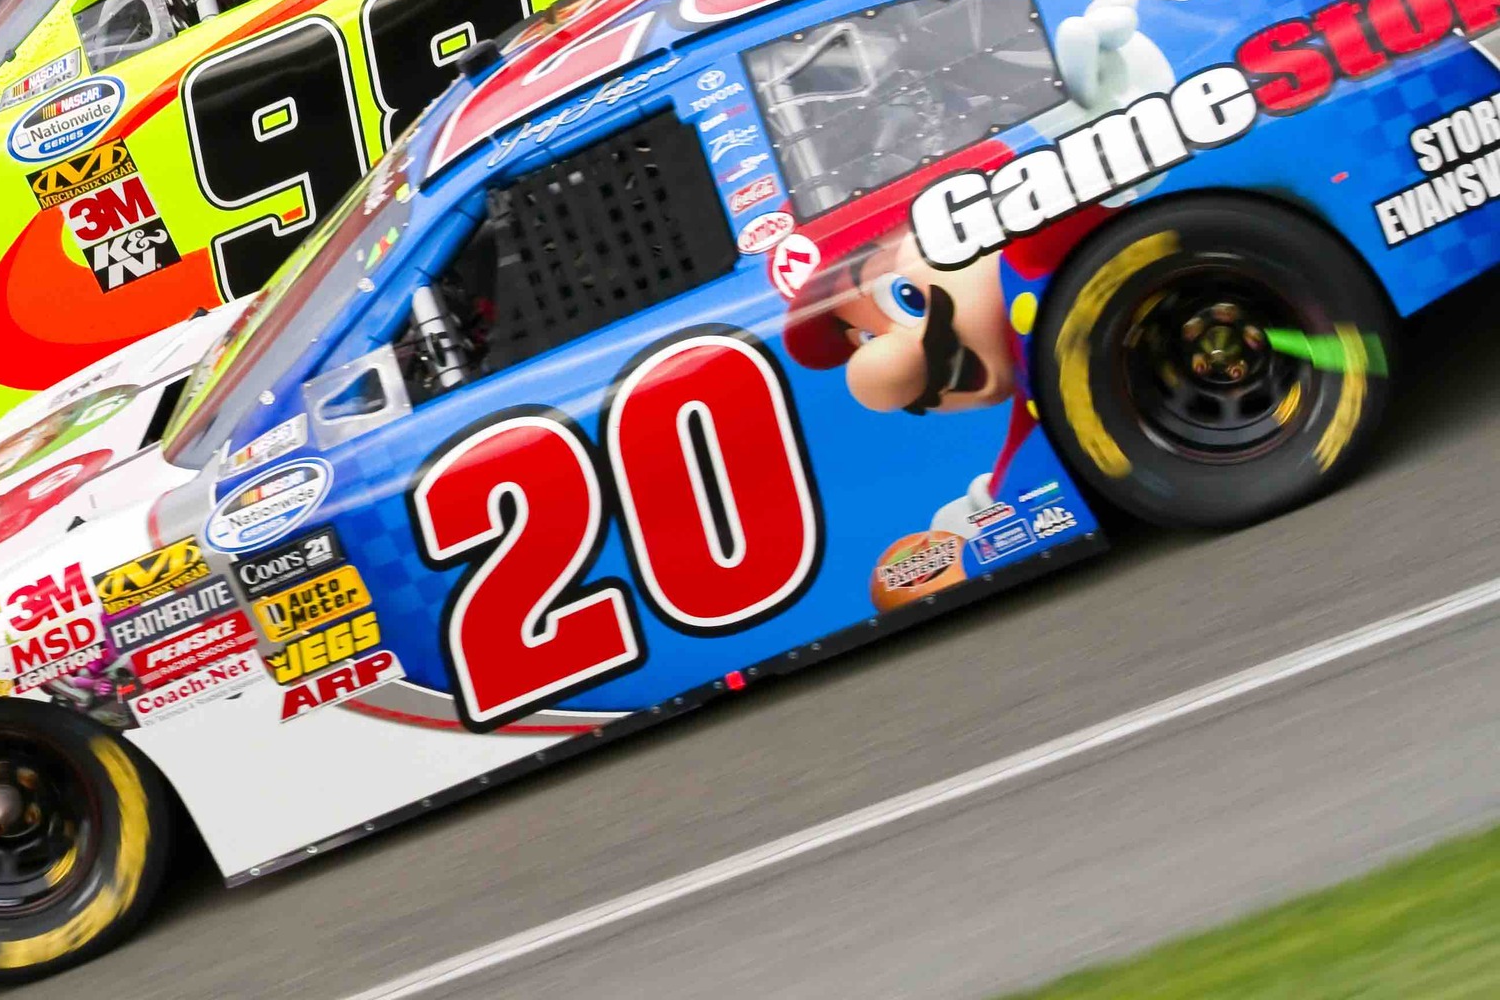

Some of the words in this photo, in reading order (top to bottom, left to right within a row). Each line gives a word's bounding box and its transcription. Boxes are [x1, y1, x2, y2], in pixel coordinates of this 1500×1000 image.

[27, 58, 68, 88] NASCAR
[689, 82, 745, 112] TOYOTA
[30, 102, 111, 143] Nationwide
[61, 86, 102, 112] NASCAR
[43, 129, 84, 152] SERIES
[38, 179, 101, 209] MECHANIX
[100, 160, 137, 185] WEAR
[68, 177, 157, 241] 3M
[1374, 148, 1500, 245] EVANSV
[94, 228, 168, 289] K&N
[228, 486, 315, 529] Nationwide
[408, 328, 822, 729] 20
[240, 550, 305, 585] Coors
[304, 535, 332, 559] 21
[879, 538, 956, 578] INTERSTATE
[7, 562, 94, 632] 3M
[110, 581, 234, 649] FEATHERLITE
[288, 579, 340, 611] Auto
[290, 588, 357, 628] Meter
[11, 616, 96, 677] MSD
[17, 645, 102, 691] IGNITION
[146, 618, 238, 669] PENSKE
[196, 640, 238, 664] SHOCKS
[276, 611, 381, 686] JEGS
[136, 657, 251, 715] Coach-Net
[281, 651, 393, 721] ARP
